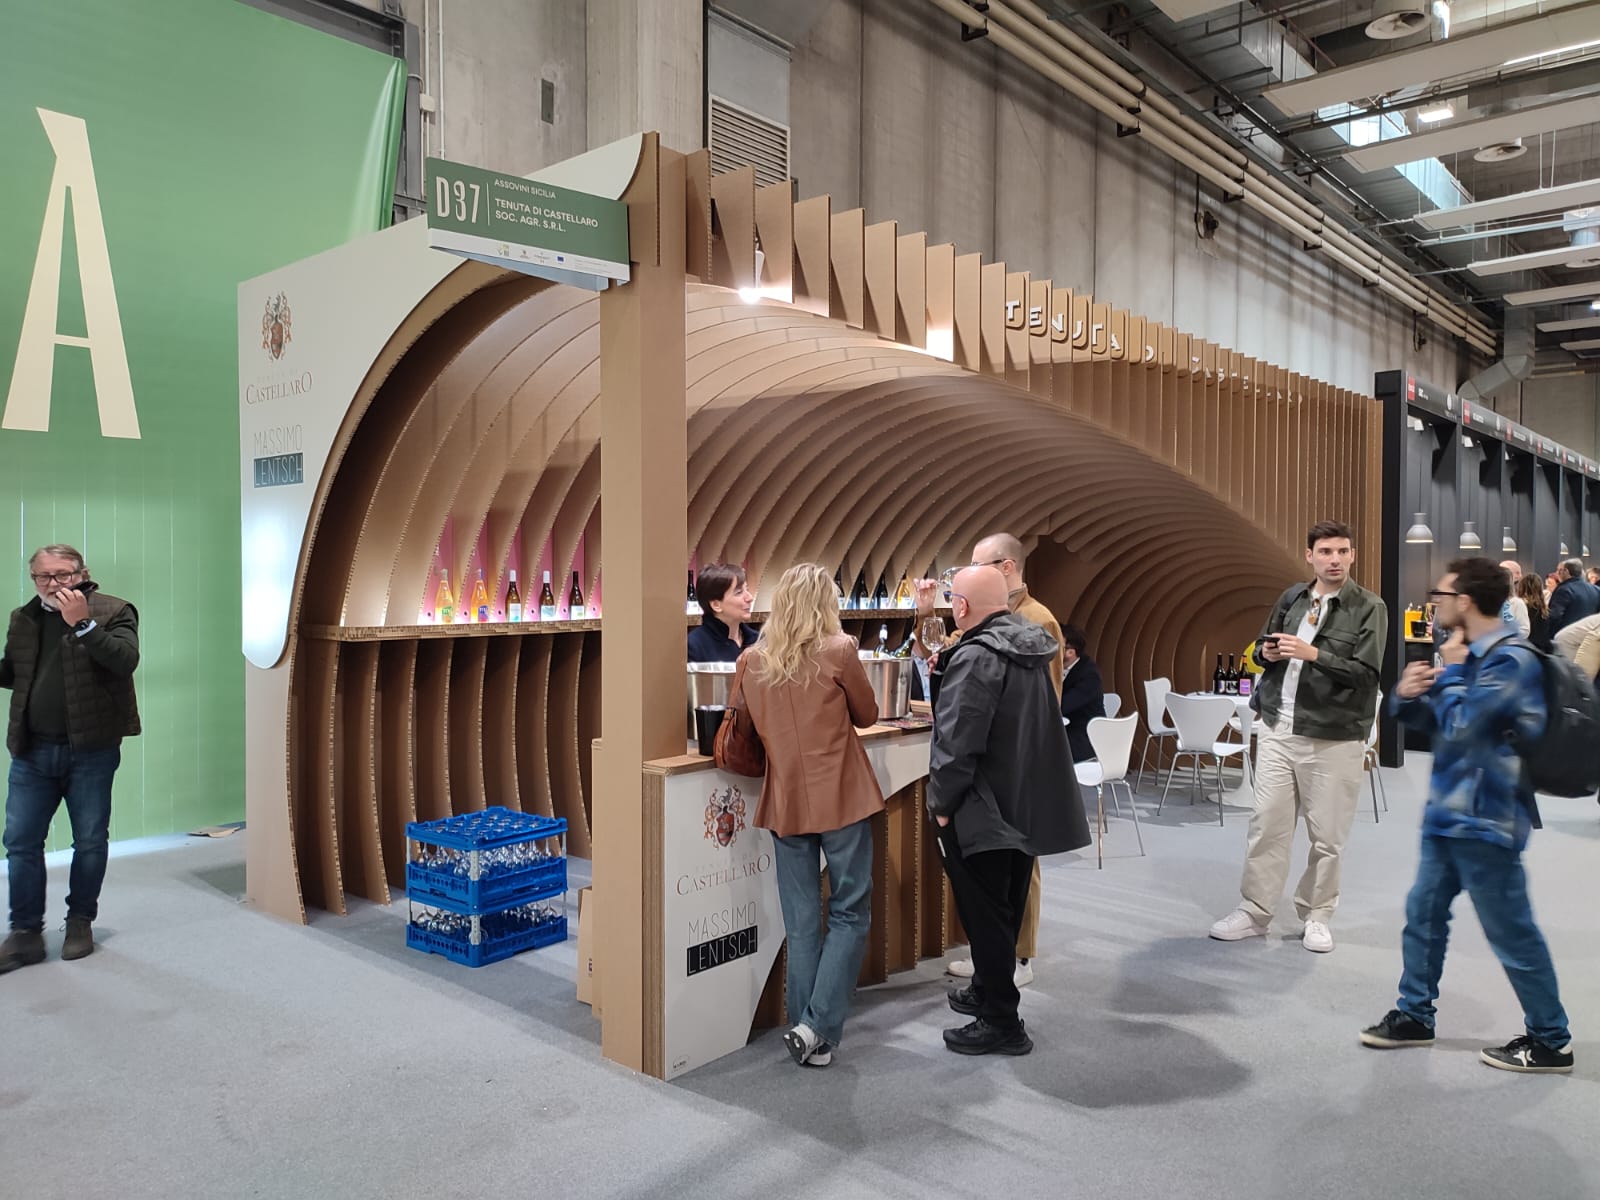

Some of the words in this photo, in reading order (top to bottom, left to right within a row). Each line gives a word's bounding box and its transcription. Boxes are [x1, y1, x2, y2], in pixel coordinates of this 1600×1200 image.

[436, 176, 480, 224] D37
[494, 179, 530, 194] ASSOVINI
[531, 187, 556, 198] SICILIA
[495, 198, 530, 213] TENUTA
[533, 206, 542, 215] DI
[543, 209, 598, 227] CASTELLARO
[495, 210, 518, 222] SOC.
[520, 215, 540, 227] AGR.
[543, 220, 566, 232] S.R.L.
[2, 107, 141, 439] A
[246, 372, 312, 404] CASTELLARO
[254, 425, 302, 456] MASSIMO
[254, 455, 303, 486] LENTSCH
[676, 853, 771, 896] CASTELLARO
[688, 901, 757, 944] MASSIMO
[687, 927, 757, 973] LENTSCH
